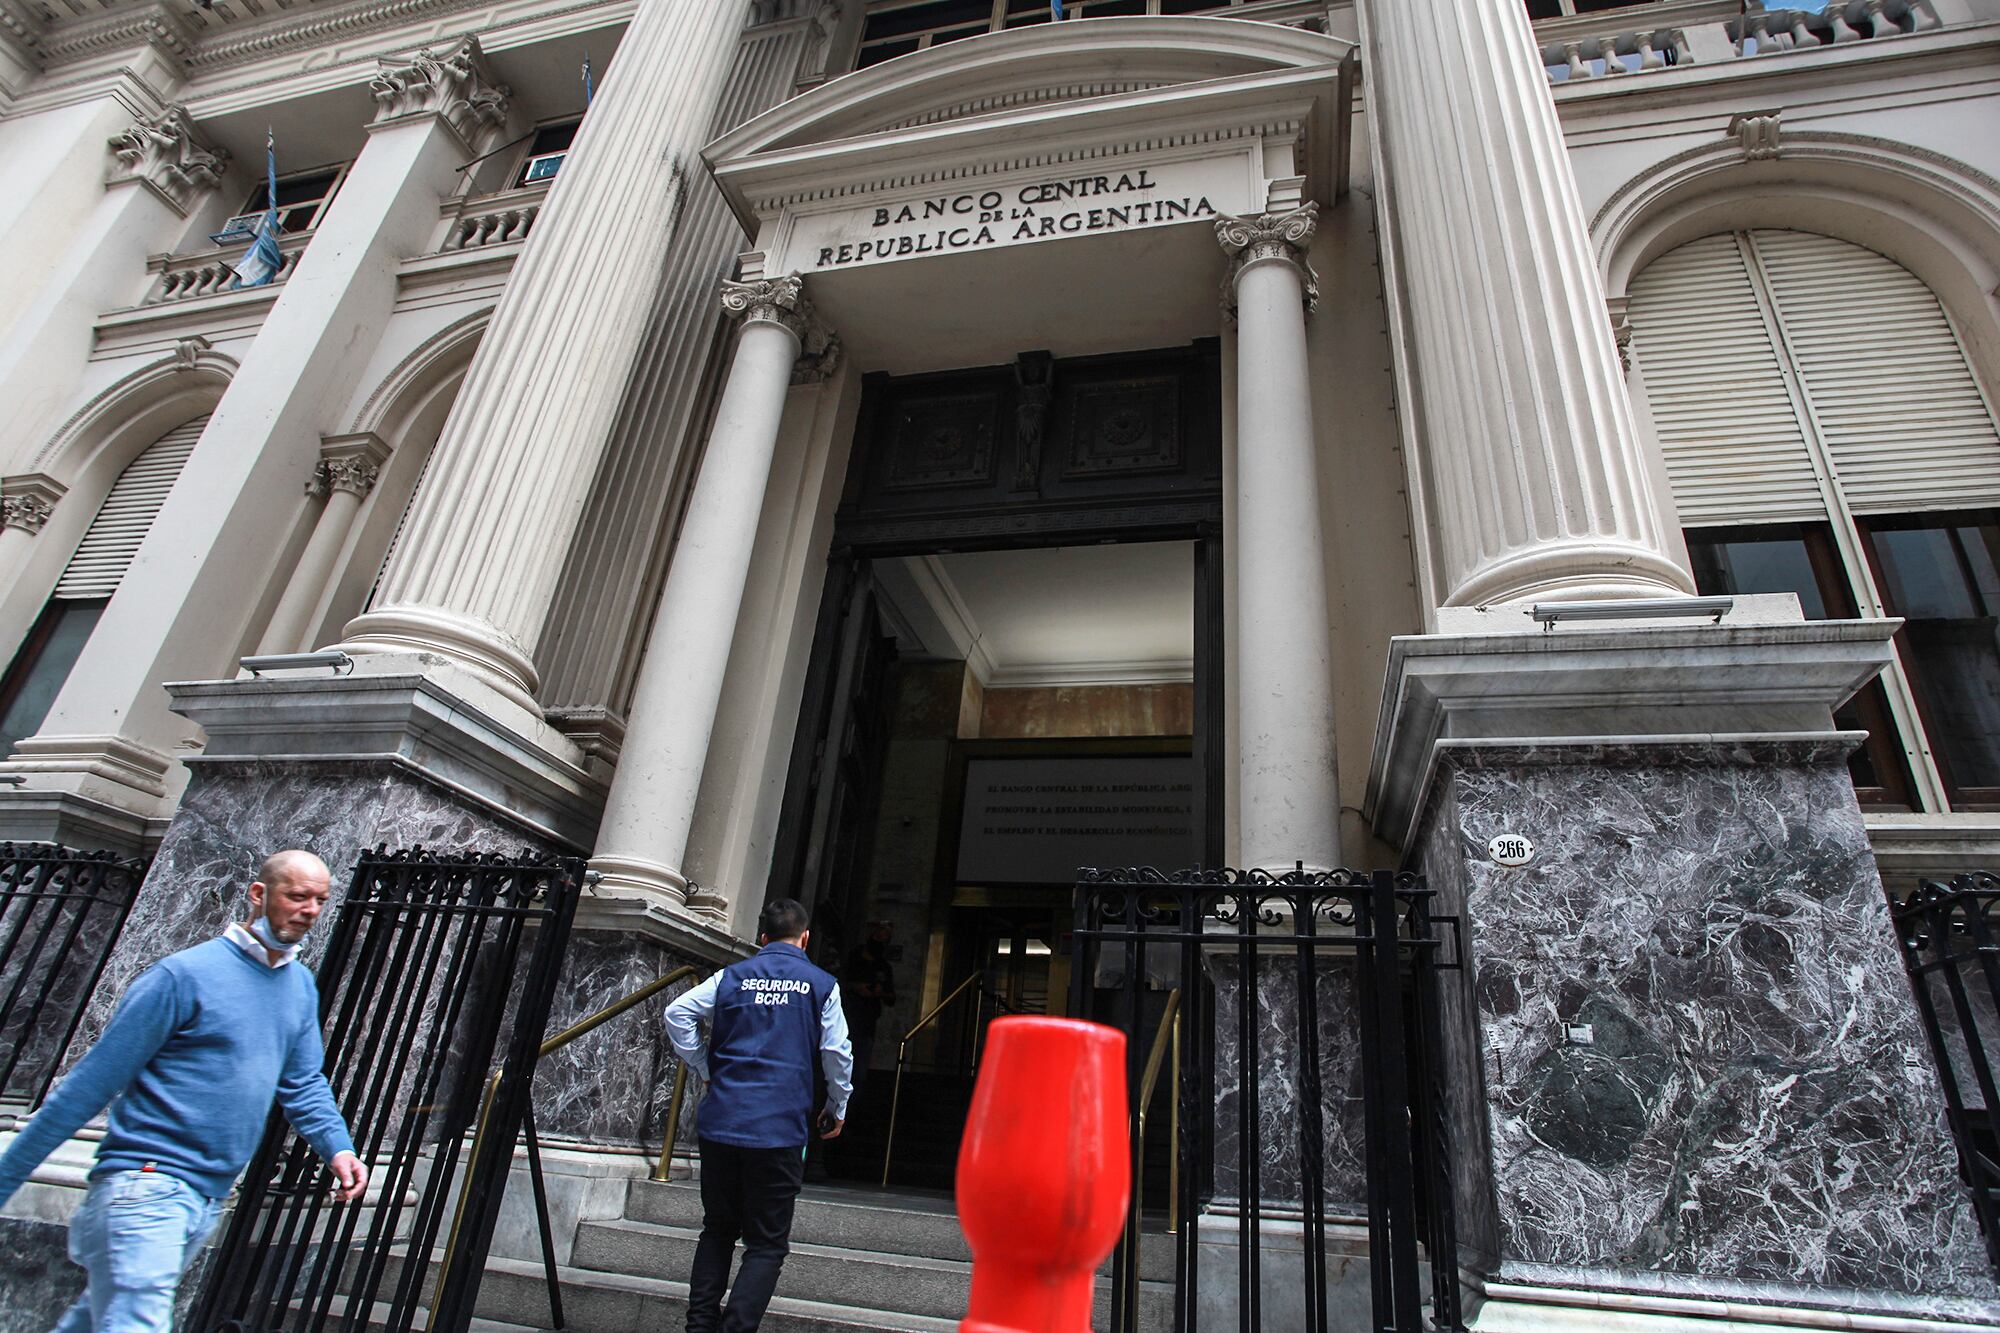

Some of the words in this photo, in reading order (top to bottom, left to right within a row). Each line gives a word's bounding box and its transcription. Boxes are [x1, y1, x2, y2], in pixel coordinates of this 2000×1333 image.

[872, 191, 1003, 227] BANCO
[1018, 171, 1156, 204] CENTRAL
[978, 210, 1004, 224] DE
[1011, 205, 1035, 219] LA
[817, 225, 995, 266] REPUBLICA
[1012, 196, 1217, 240] ARGENTINA
[1001, 785, 1033, 793] BANCO
[1035, 785, 1079, 793] CENTRAL
[1081, 785, 1093, 793] DE
[1096, 784, 1109, 793] LA
[984, 806, 1038, 814] PROMOVER
[1040, 806, 1052, 814] LA
[1054, 806, 1120, 814] ESTABILIDAD
[983, 827, 995, 835] EL
[997, 827, 1035, 835] EMPLEO
[1046, 827, 1057, 835] EL
[1060, 827, 1124, 836] DESARROLLO
[1497, 840, 1526, 859] 266
[741, 978, 811, 995] SEGURIDAD
[754, 992, 789, 1005] BCRA
